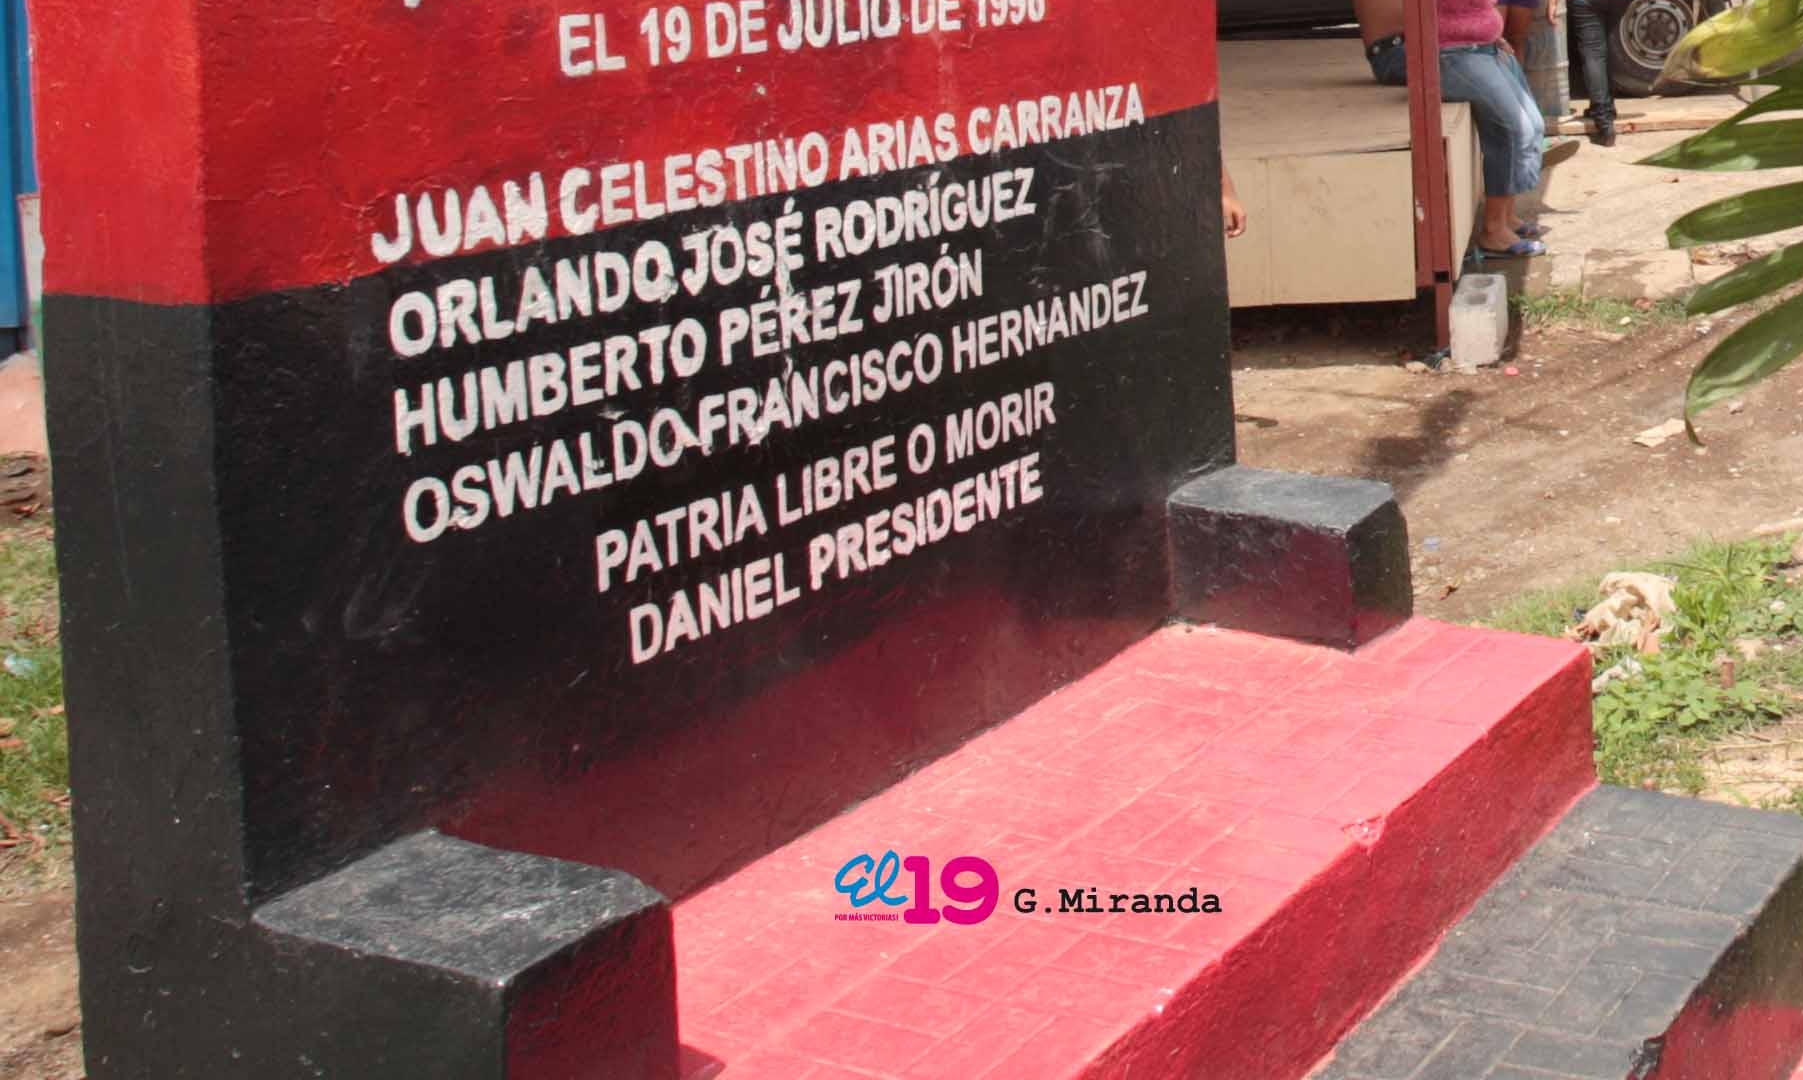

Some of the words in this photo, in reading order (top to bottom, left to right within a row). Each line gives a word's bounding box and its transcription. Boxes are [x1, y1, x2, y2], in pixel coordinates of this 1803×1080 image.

[558, 12, 628, 78] EL
[639, 5, 692, 67] 19
[369, 171, 549, 264] JUAN
[558, 130, 829, 237] CELESTINO
[838, 112, 957, 182] ARIAS
[967, 82, 1146, 156] CARRANZA
[388, 240, 677, 359] ORLANDO
[681, 196, 804, 297] JOSÉ
[814, 167, 1038, 263] RODRÍGUEZ
[392, 317, 708, 457] HUMBERTO
[719, 283, 864, 366] PÉREZ
[872, 242, 984, 324] JIRÓN
[402, 405, 686, 544] OSWALDO
[697, 331, 945, 457] FRANCISCO
[952, 270, 1149, 374] HERNANDEZ
[595, 483, 767, 593] PATRIA
[775, 433, 898, 527] LIBRE
[906, 421, 936, 475] O
[944, 380, 1056, 465] MORIR
[629, 551, 801, 666] DANIEL
[808, 452, 1044, 592] PRESIDENTE
